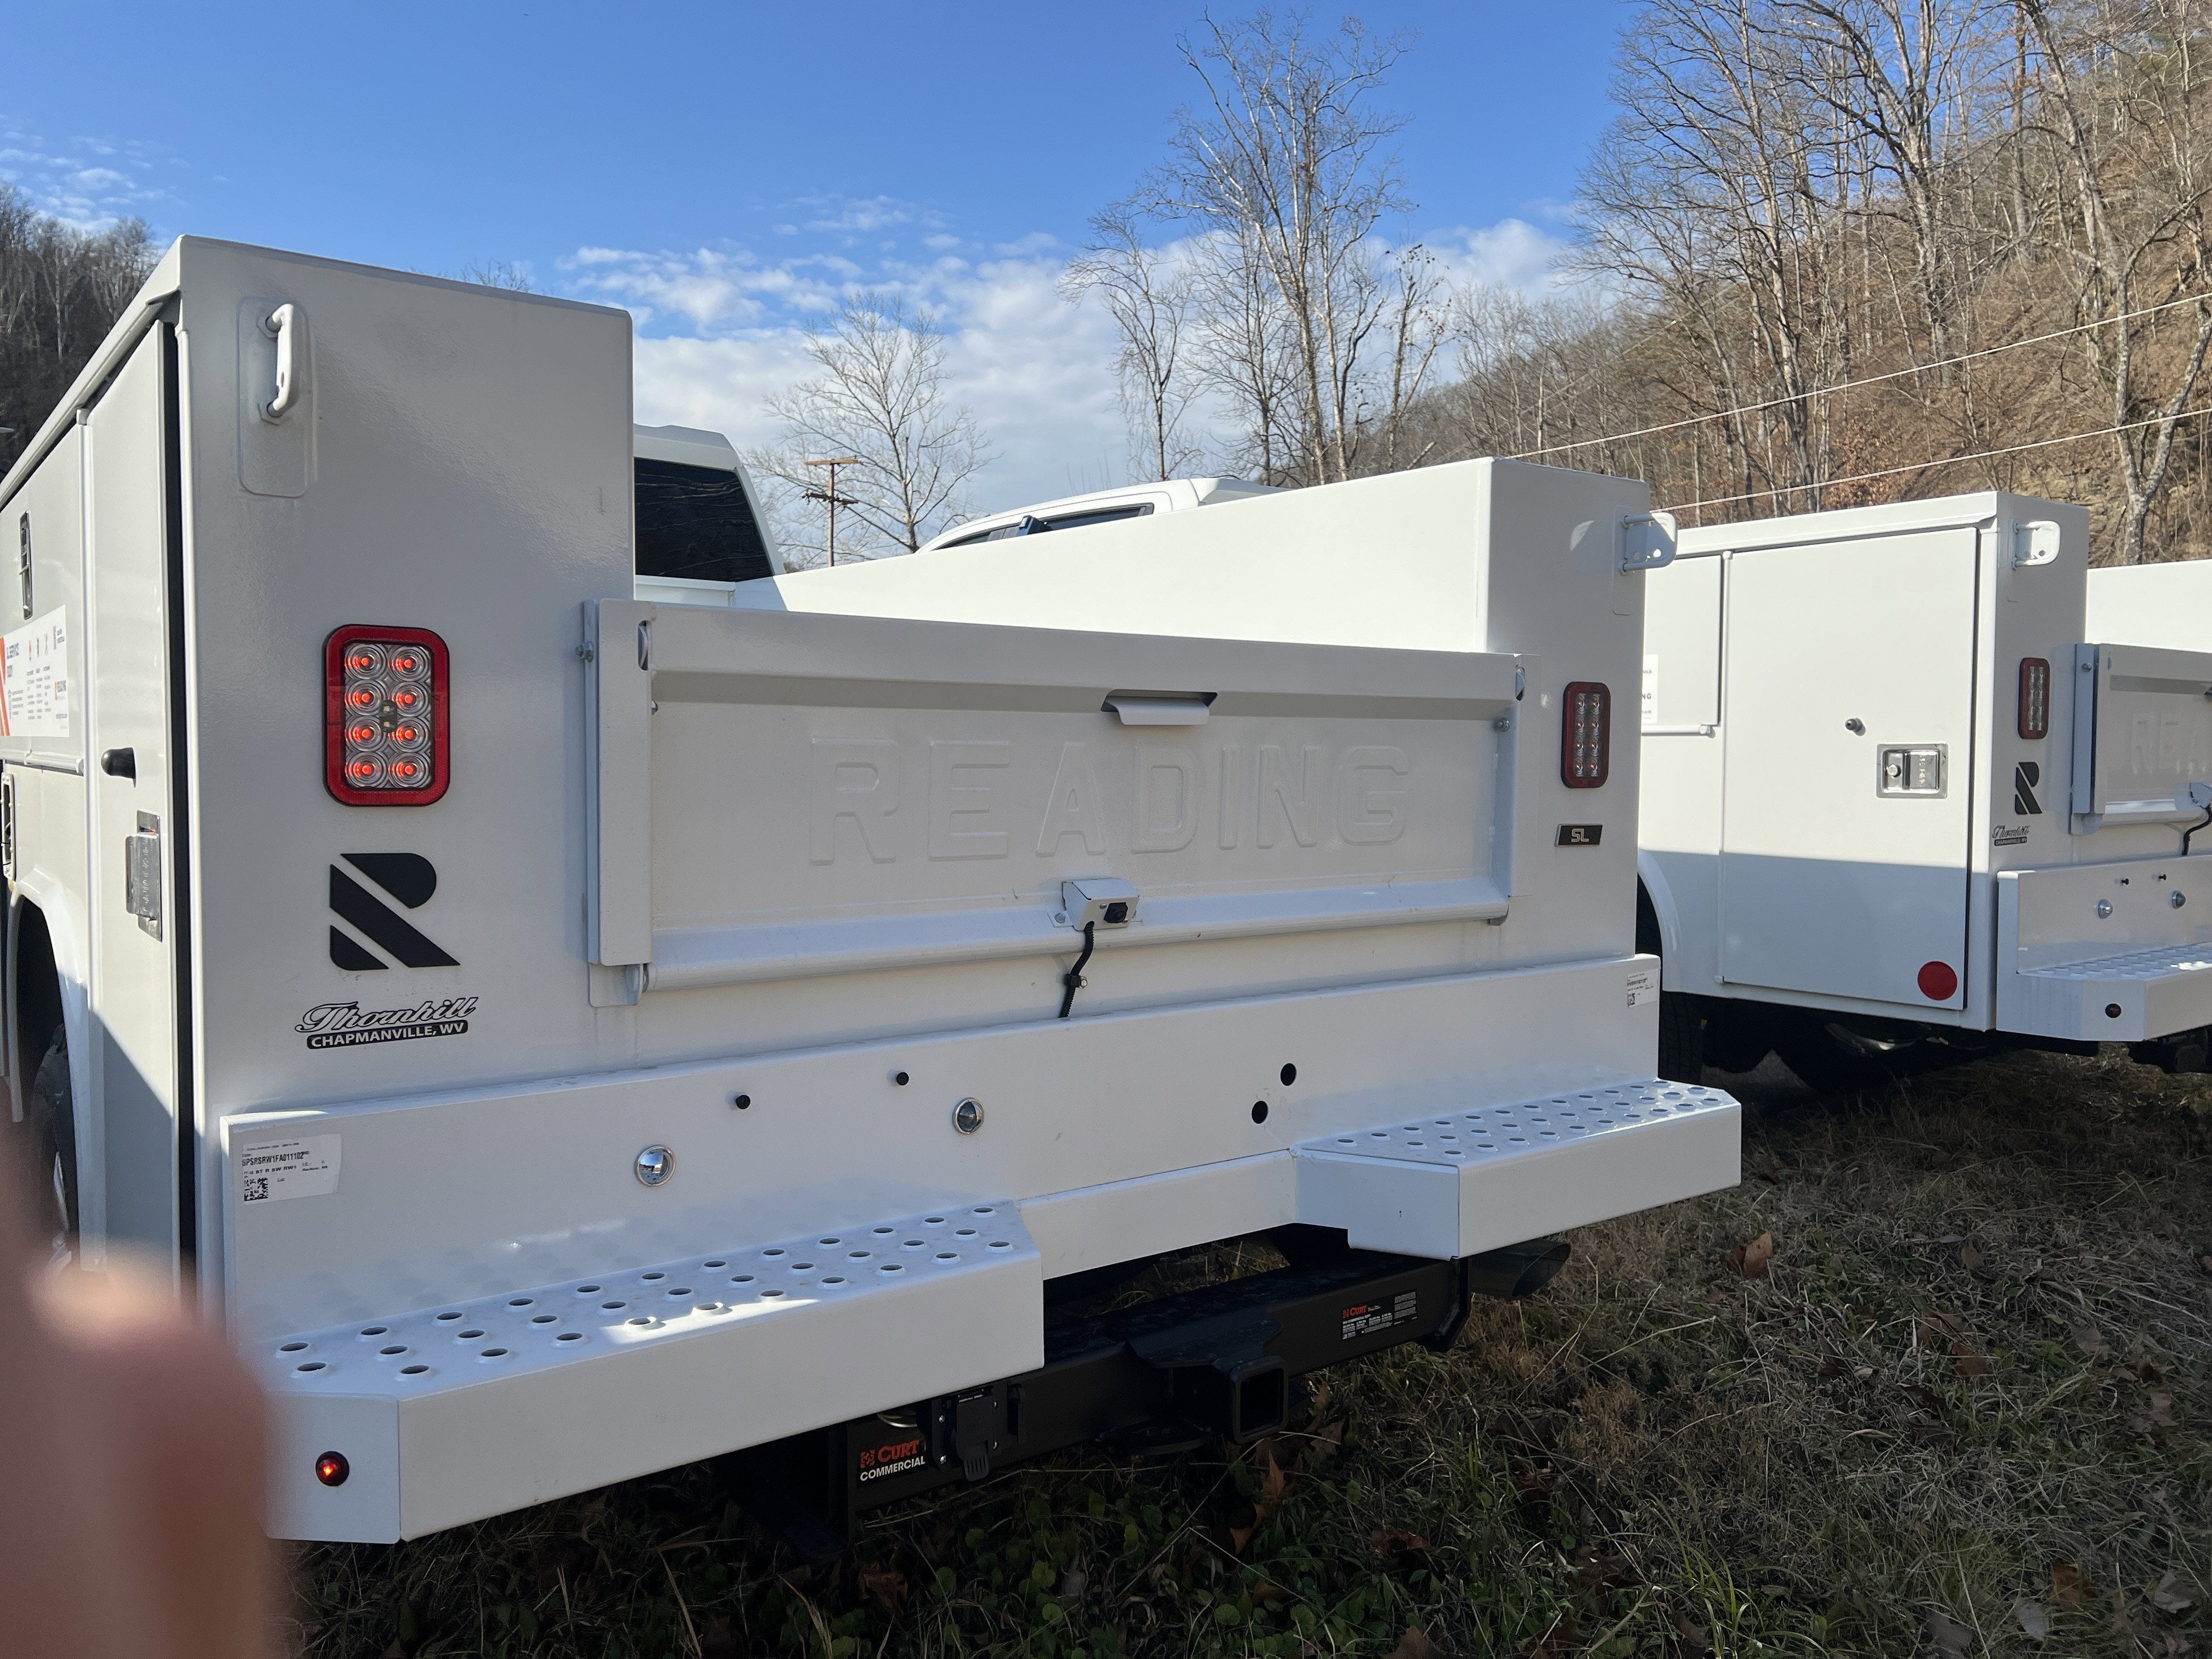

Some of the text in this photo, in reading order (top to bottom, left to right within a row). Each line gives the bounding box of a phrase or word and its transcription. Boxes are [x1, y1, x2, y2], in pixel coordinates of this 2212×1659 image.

[809, 735, 1410, 866] READING
[1571, 828, 1589, 842] SL
[295, 997, 478, 1032] Thornhill
[311, 1022, 465, 1047] CHAPMANVILLE, WV
[878, 1439, 919, 1463] CURT
[860, 1456, 926, 1482] COMMERCIAL
